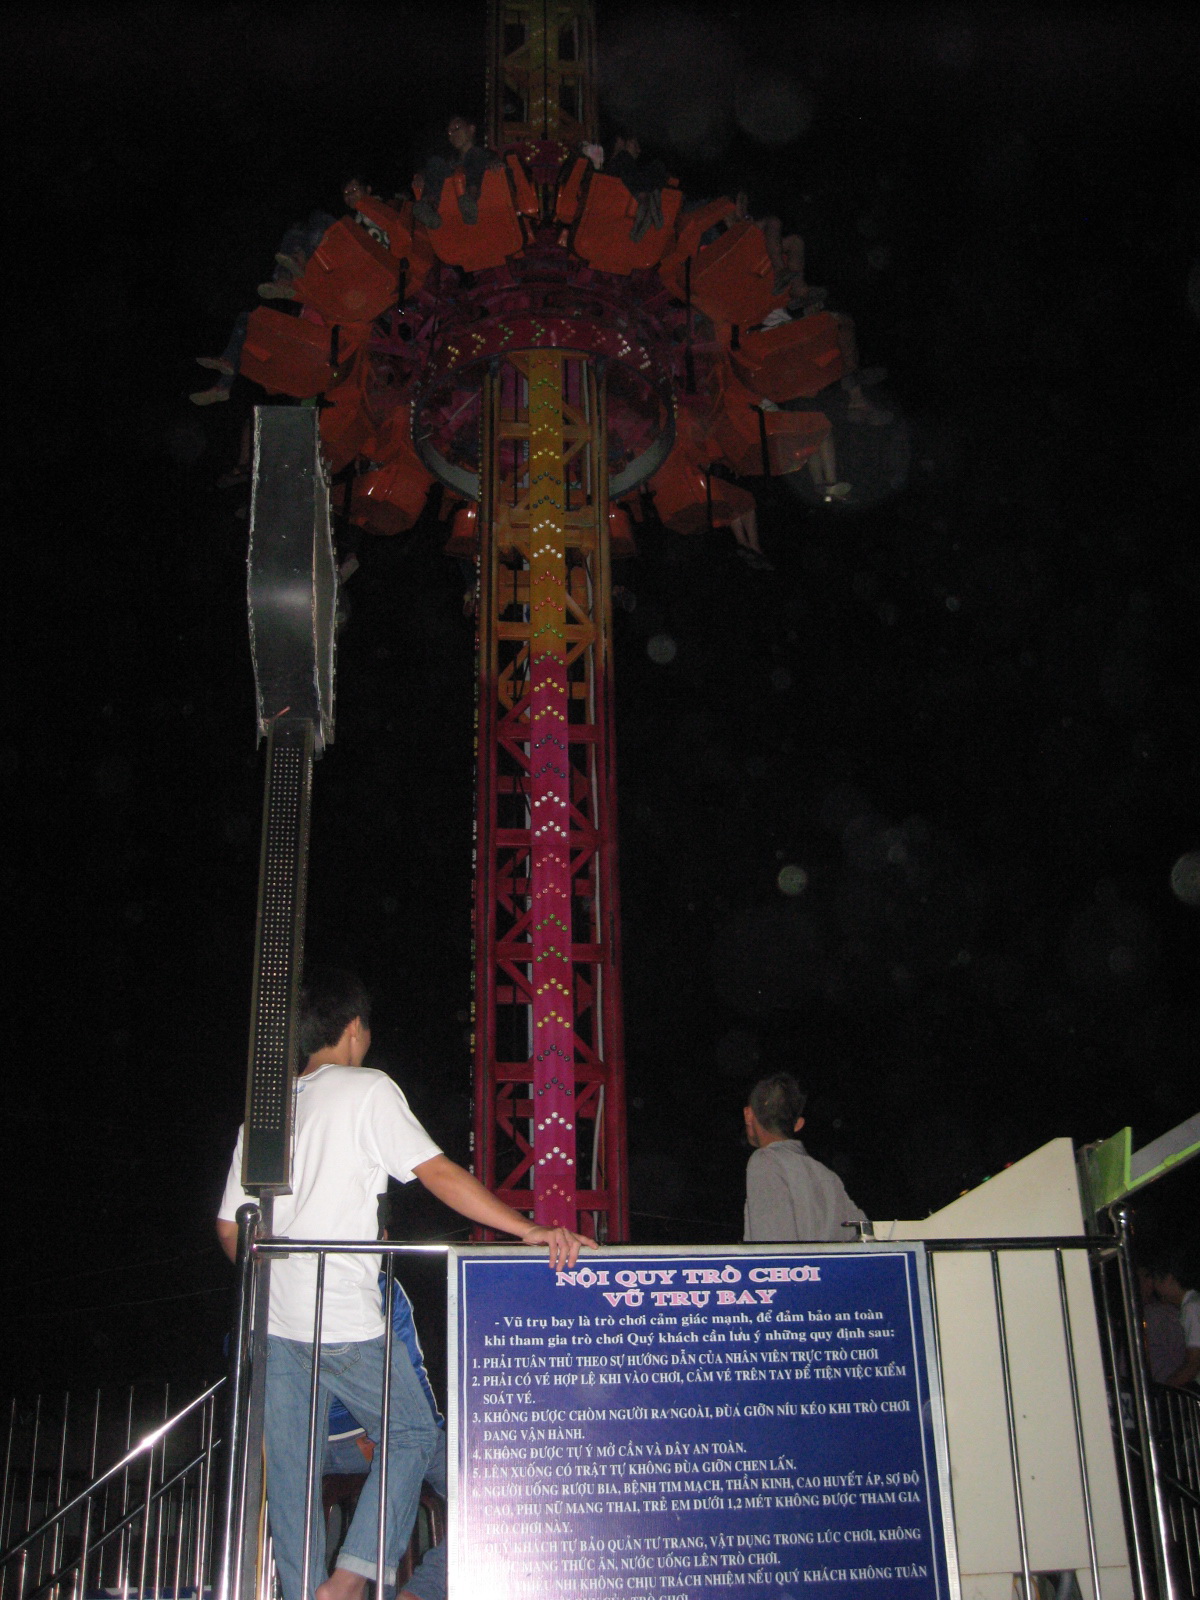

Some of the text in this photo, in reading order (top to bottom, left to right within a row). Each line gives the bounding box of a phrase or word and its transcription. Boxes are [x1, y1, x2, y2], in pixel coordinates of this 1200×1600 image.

[555, 1265, 821, 1288] NỘI QUY TRÒ CHƠI
[603, 1289, 777, 1309] VŨ TRỤ BAY
[504, 1309, 883, 1329] Vũ trụ bay là trò chơi cảm giác mạnh, để đảm bảo an toàn
[485, 1328, 895, 1347] khi tham gia trò chơi Quý khách cần những quy định sau:
[484, 1348, 878, 1368] PHẢI TUÂN THỦ THEO SỰ HƯỚNG DẪN CỦA NHÂN VIÊN TRỰC TRÒ CHƠI
[484, 1361, 906, 1387] PHẢI CÓ VÉ HỢP LỆ KHI VÀO CHƠI, VÉ TRÊN TAY ĐỂ TIỆN VIỆC KIỂM
[484, 1390, 535, 1404] SOÁT VÉ.
[484, 1399, 909, 1423] KHÔNG ĐƯỢC NGƯỜI RA NGOÀI, GIỠN NÍU KÉO KHI TRÒ CHƠI
[484, 1427, 585, 1441] ĐANG VẬN HÀNH.
[484, 1440, 746, 1459] KHÔNG ĐƯỢC TỰ MỞ VÀ DÂY AN TOÀN.
[484, 1459, 767, 1478] LÊN XUỐNG CÓ TRẬT TỰ KHÔNG ĐÙA GIỠN CHEN
[484, 1470, 919, 1496] NGƯỜI UỐNG RƯỢU BIA, BỆNH TIM MẠCH, THẦN KINH, CAO ÁP, SỢ ĐỘ
[517, 1491, 920, 1516] PHỤ NỮ MANG THAI, TRẺ EM DƯỚI 1,2 MÉT KHÔNG ĐƯỢC THAM GIA
[485, 1519, 573, 1535] TRÒ CHƠI NÀY.
[561, 1526, 921, 1552] TỰ BẢO QUẢN TƯ TRANG, VẬT DỤNG TRONG LÚC CHƠI, KHÔNG
[562, 1552, 781, 1571] THỨC ĂN, NƯỚC UỐNG LÊN CHƠI.
[555, 1563, 927, 1590] NHI KHÔNG CHỊU TRÁCH NHIỆM NẾU QUÝ KHÁCH KHÔNG TUÂN
